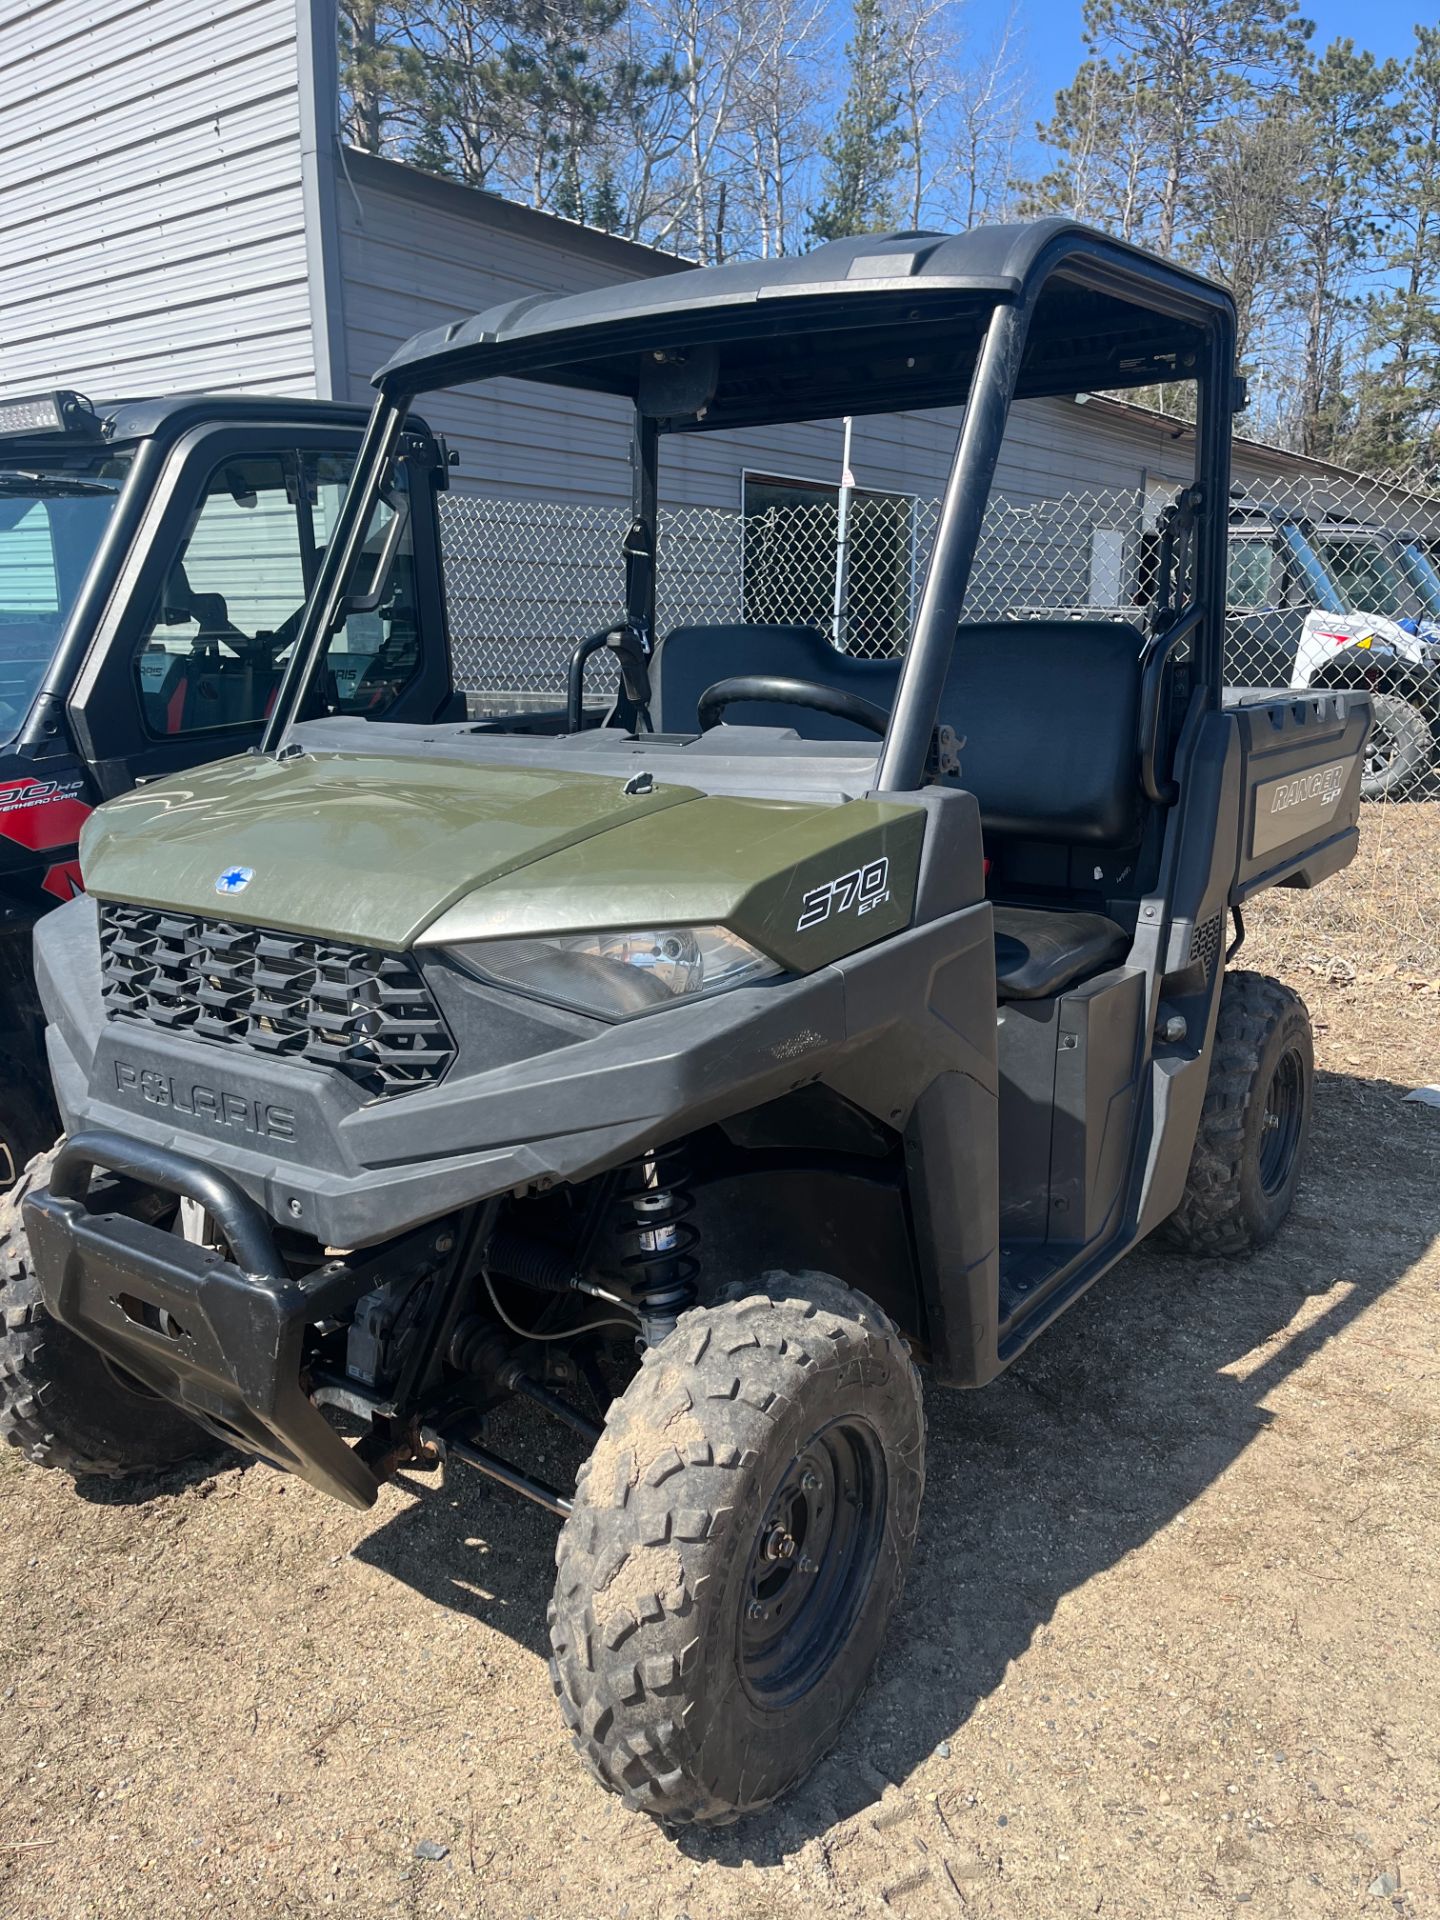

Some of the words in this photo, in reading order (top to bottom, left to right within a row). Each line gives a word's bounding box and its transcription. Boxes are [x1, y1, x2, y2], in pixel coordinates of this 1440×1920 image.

[53, 792, 78, 802] CAM
[1271, 766, 1343, 813] RANGER
[1320, 788, 1341, 806] SP
[797, 857, 888, 932] 570
[858, 890, 890, 916] EFI
[114, 1060, 297, 1144] POLARIS
